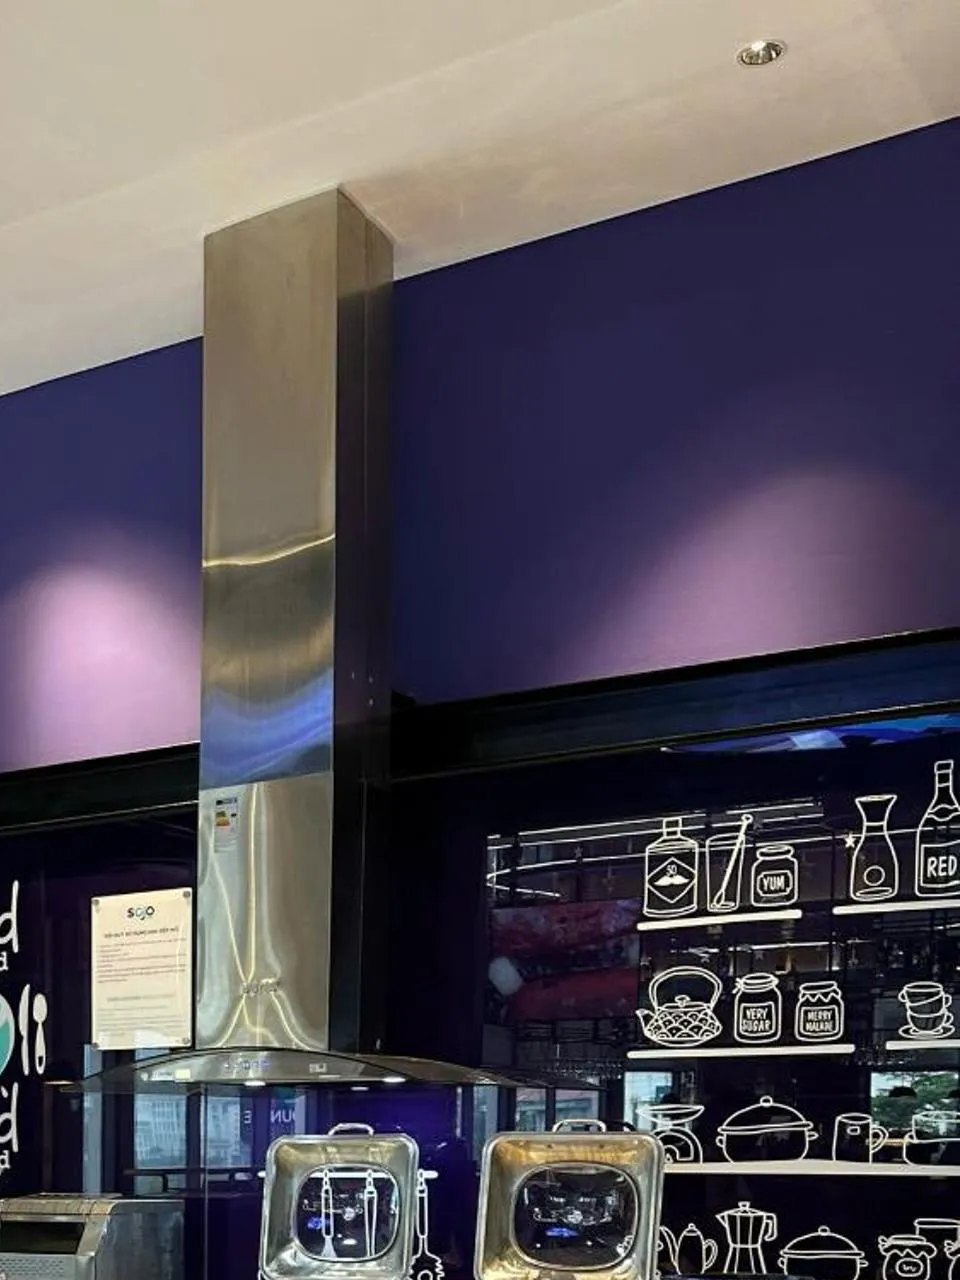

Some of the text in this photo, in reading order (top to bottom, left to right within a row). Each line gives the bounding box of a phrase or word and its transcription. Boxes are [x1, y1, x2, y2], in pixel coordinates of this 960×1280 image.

[927, 855, 957, 878] RED
[763, 875, 785, 891] YUM
[746, 1008, 768, 1019] VERY
[742, 1020, 771, 1032] SUGAR
